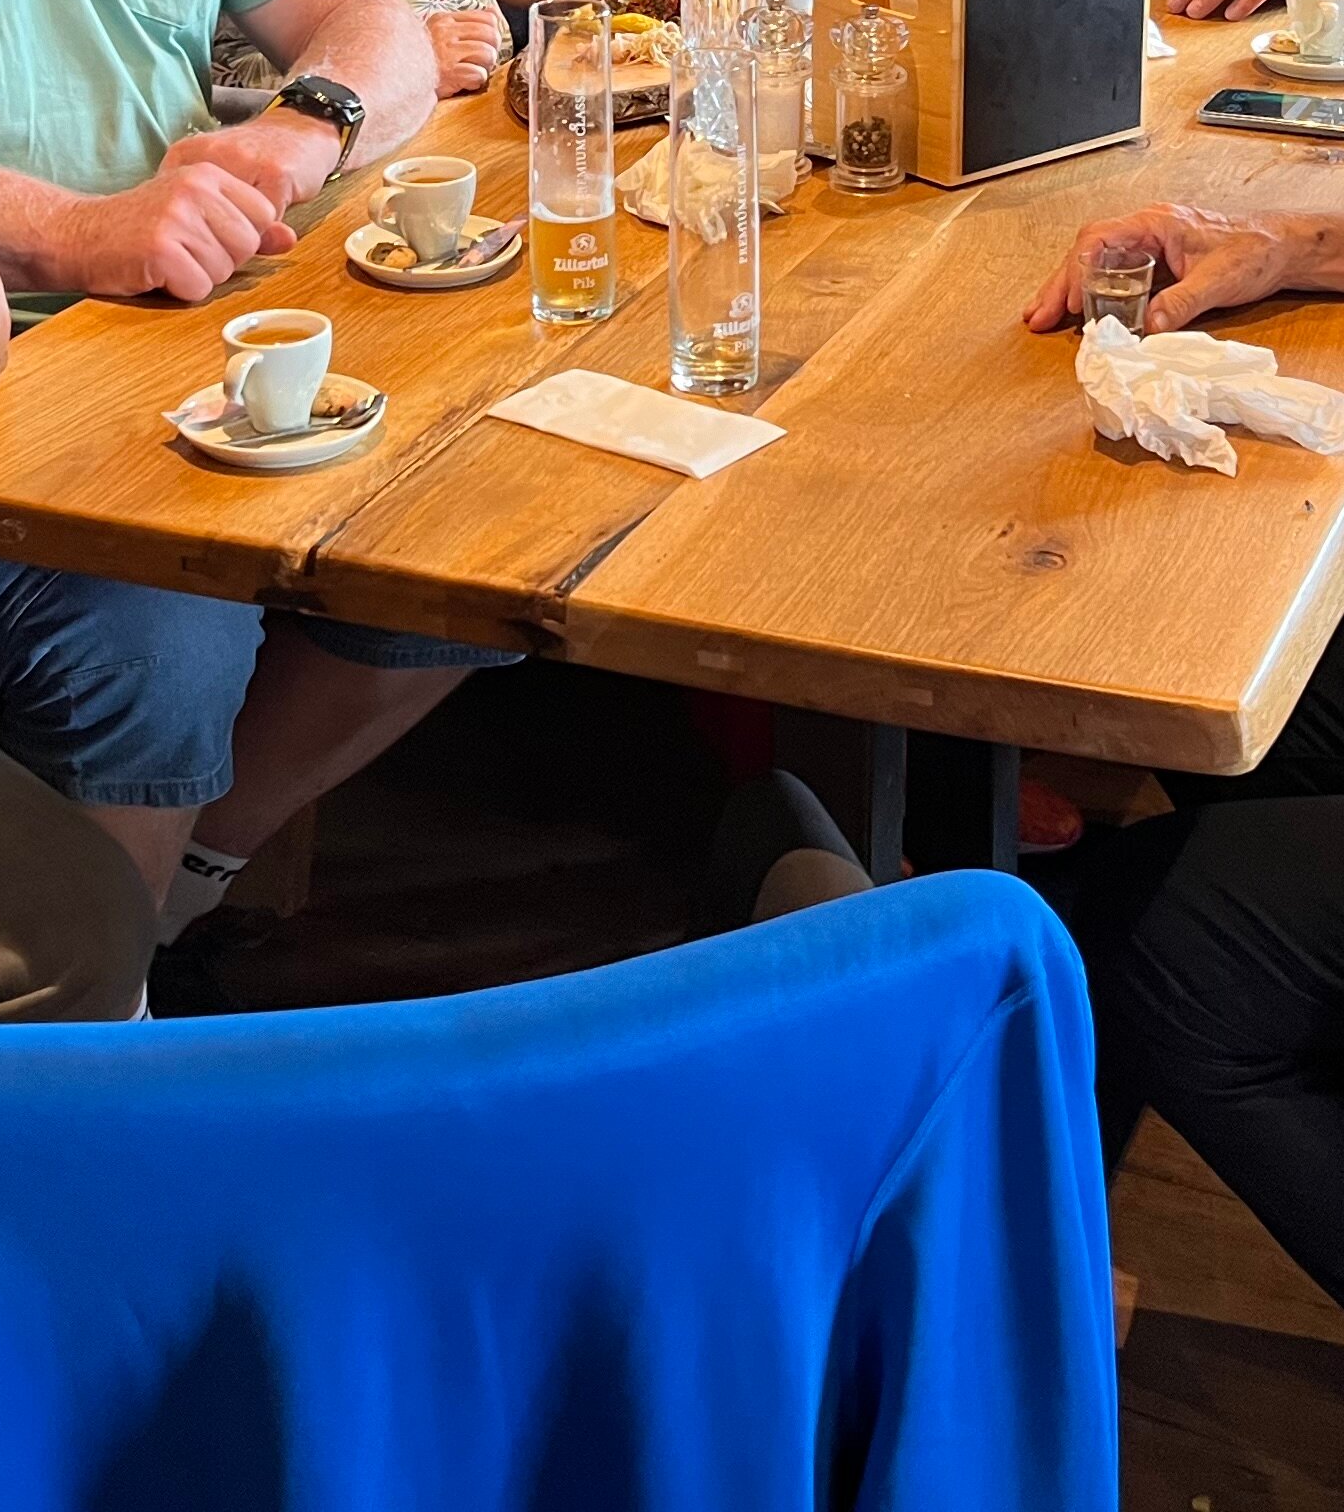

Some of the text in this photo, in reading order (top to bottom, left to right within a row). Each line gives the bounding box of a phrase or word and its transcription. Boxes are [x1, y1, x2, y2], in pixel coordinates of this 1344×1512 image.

[737, 197, 748, 265] PREMIUM
[553, 253, 609, 272] Zillertal
[572, 276, 596, 290] Pils
